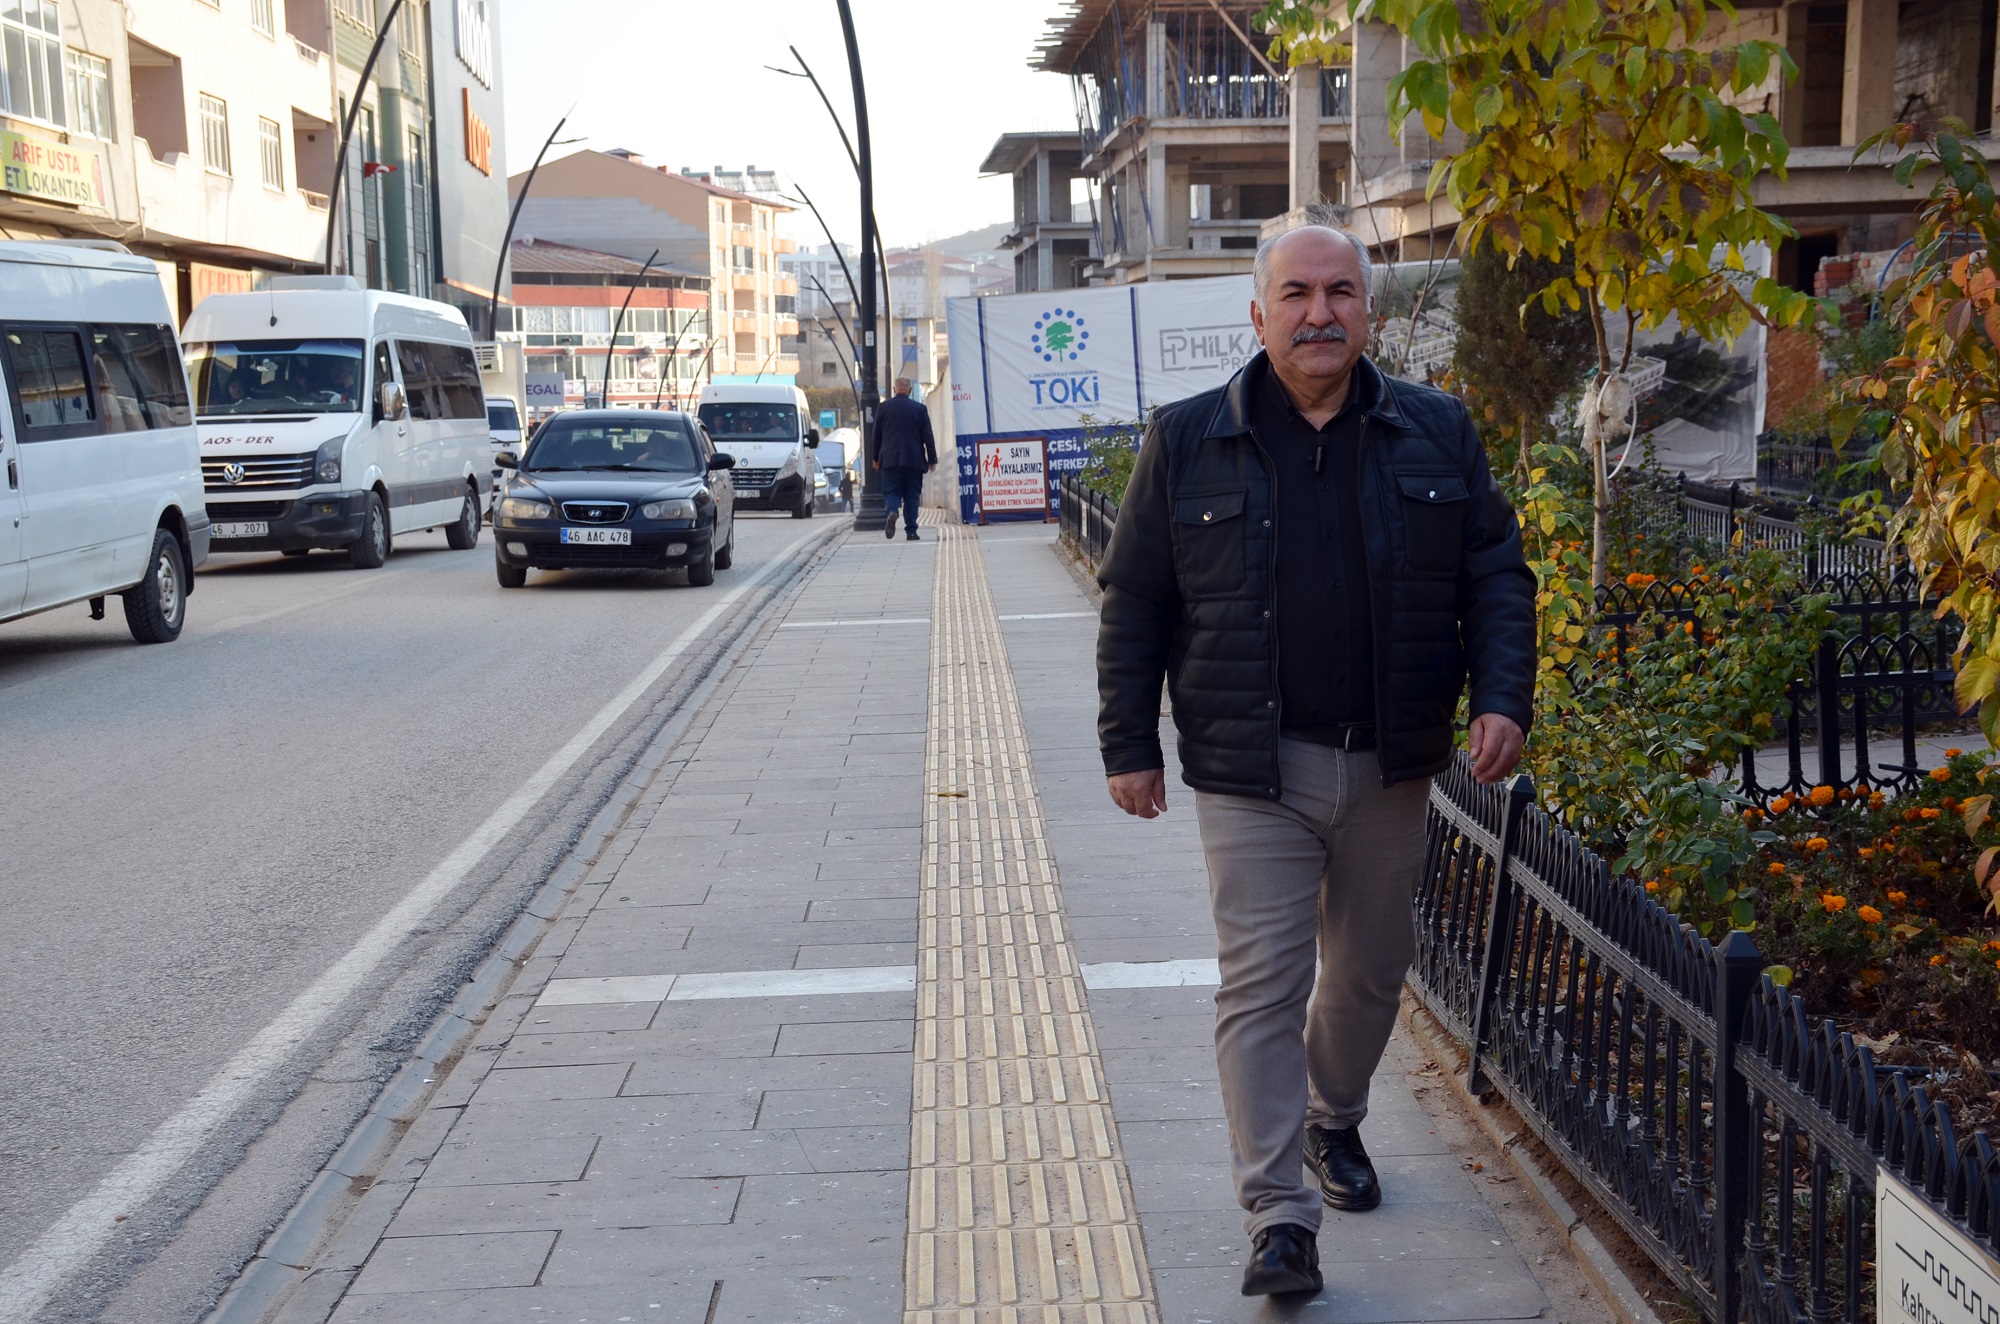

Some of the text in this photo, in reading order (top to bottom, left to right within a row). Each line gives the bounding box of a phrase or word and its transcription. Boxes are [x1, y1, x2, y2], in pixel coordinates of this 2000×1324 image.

[13, 140, 81, 175] ARİF USTA
[5, 165, 92, 202] ET LOKANTASI
[526, 383, 560, 395] EGAL
[204, 436, 233, 445] AOS
[245, 436, 275, 444] DER
[1047, 437, 1081, 454] ÇESİ,
[1010, 447, 1030, 458] SAYIN
[1000, 463, 1042, 475] YAYALARIMIZ
[1049, 457, 1088, 470] MERKEZ
[212, 523, 266, 535] 46 J 2071
[568, 531, 628, 542] 46 AAC 478
[1901, 1277, 1945, 1324] Kahr
